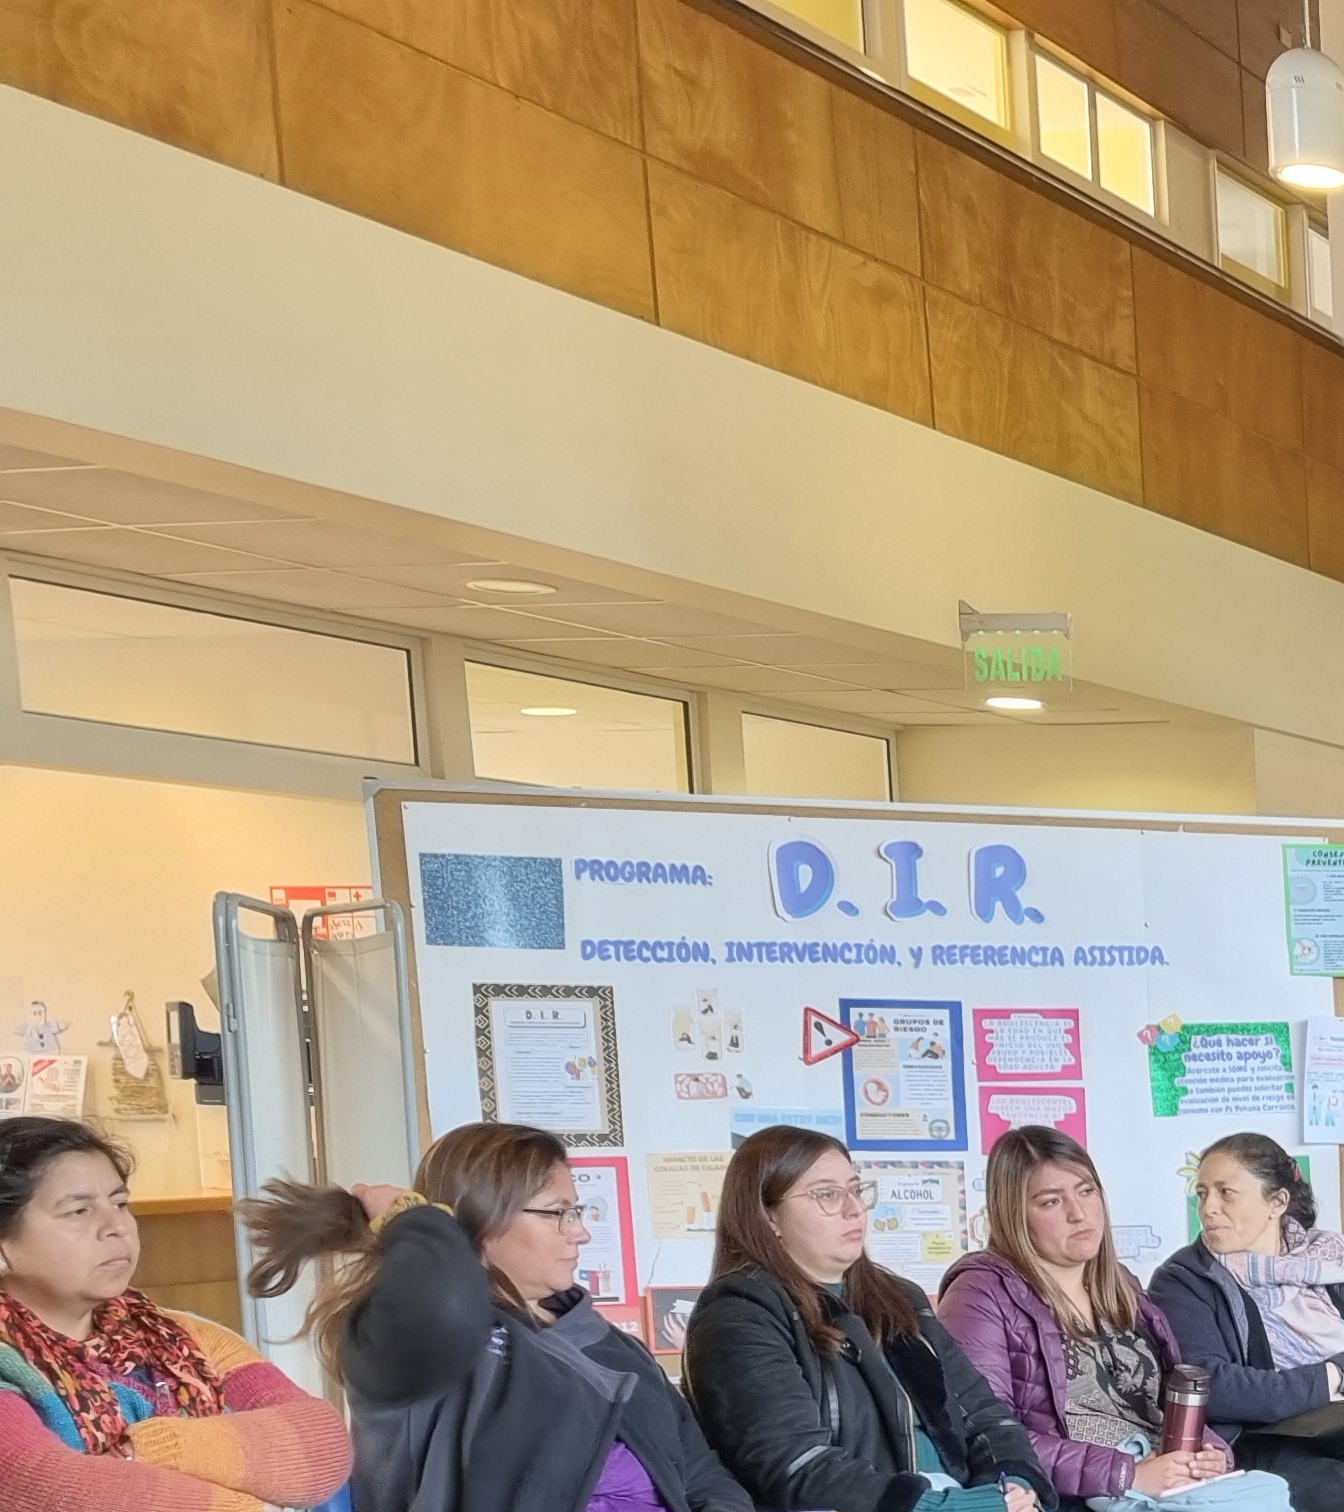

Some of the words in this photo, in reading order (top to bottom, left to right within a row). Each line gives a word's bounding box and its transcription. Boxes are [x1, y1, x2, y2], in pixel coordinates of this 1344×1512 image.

[974, 646, 1063, 683] SALIDA
[574, 858, 714, 887] PROGRAMA:
[772, 840, 859, 919] D.
[883, 841, 948, 919] I.
[972, 844, 1046, 925] R.
[580, 936, 717, 965] DETECCIÓN,
[724, 939, 902, 968] INTERVENCIÓN,
[931, 944, 1066, 968] REFERENCIA
[1073, 944, 1170, 968] ASISTIDA.
[893, 1018, 931, 1026] GRUPOS
[1192, 1036, 1223, 1049] ¿Qué
[1226, 1036, 1260, 1047] hacer
[1184, 1050, 1233, 1062] necesito
[1236, 1048, 1280, 1064] apoyo?
[1210, 1076, 1236, 1084] médica
[1237, 1075, 1254, 1085] para
[1227, 1085, 1252, 1096] puedes
[1221, 1095, 1230, 1103] de
[1251, 1094, 1260, 1102] de
[1261, 1094, 1284, 1104] riesgo
[890, 1188, 935, 1200] ALCOHOL
